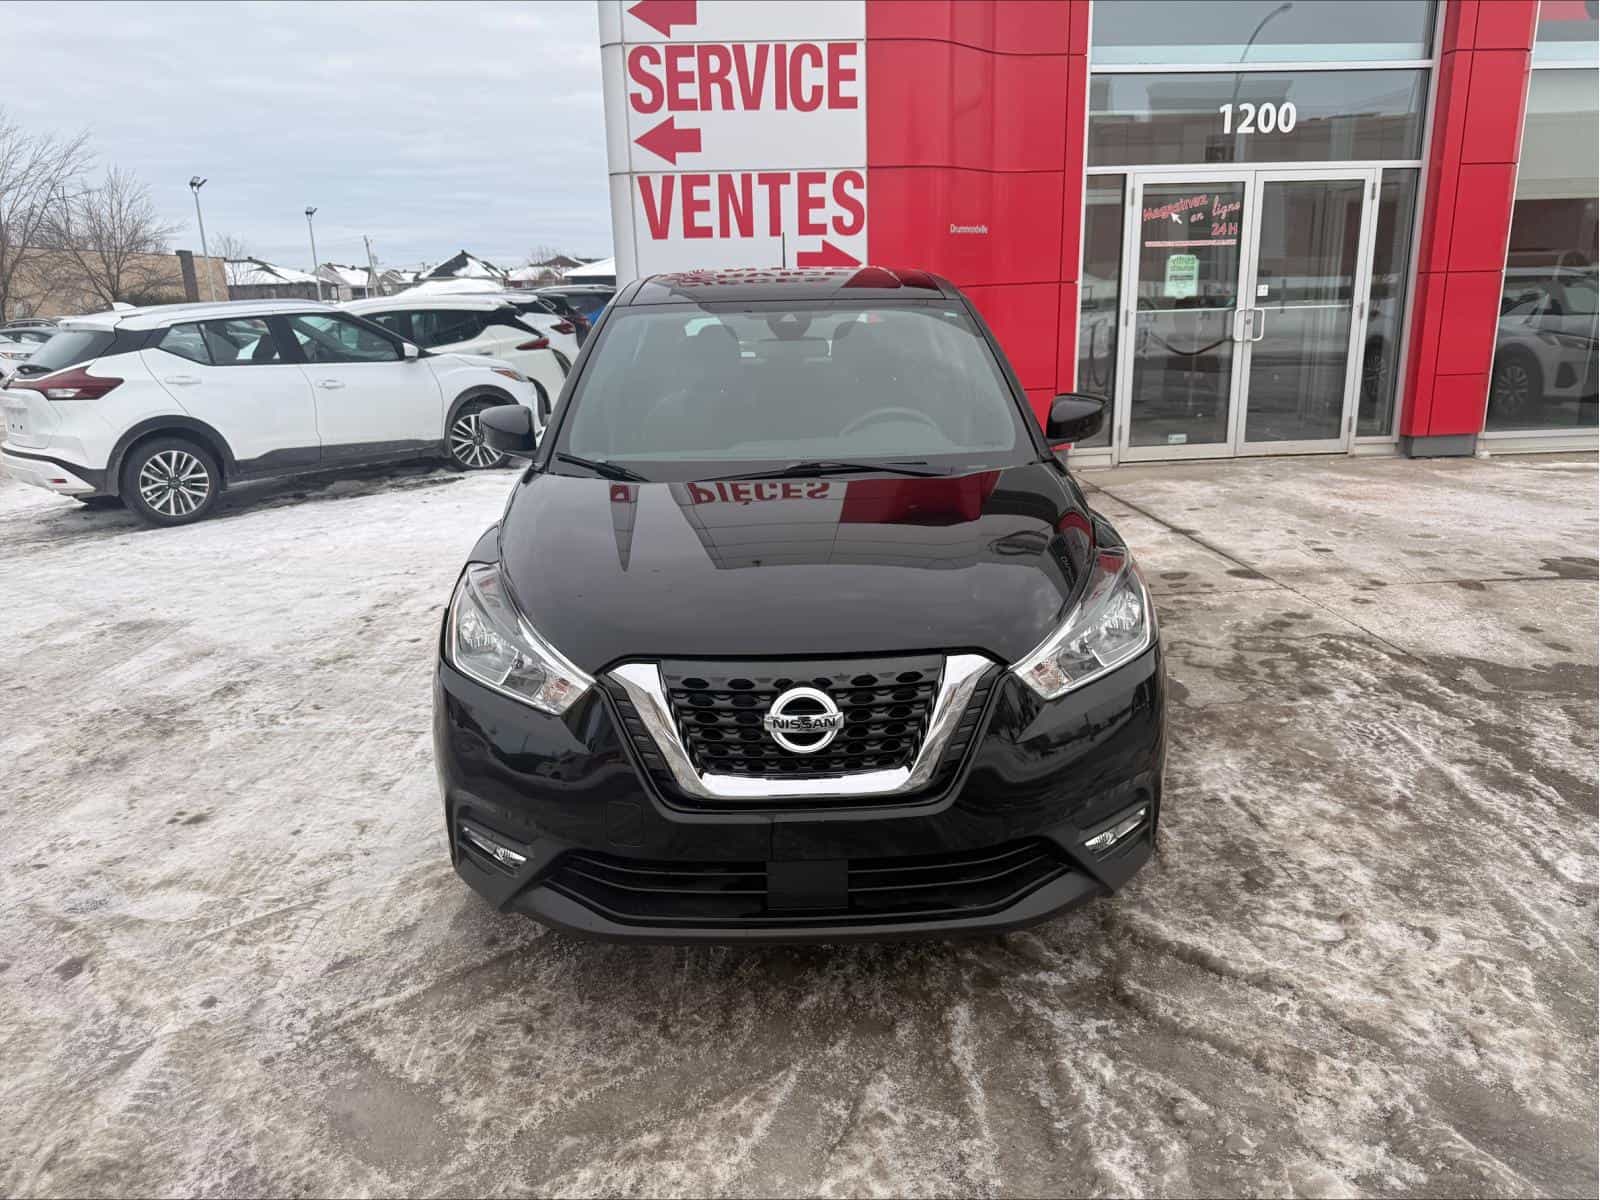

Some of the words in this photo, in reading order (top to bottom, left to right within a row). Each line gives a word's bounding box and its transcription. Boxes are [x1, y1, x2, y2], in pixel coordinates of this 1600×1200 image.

[627, 42, 859, 114] SERVICE
[1219, 102, 1297, 134] 1200
[637, 170, 866, 240] VENTES
[773, 718, 836, 729] NISSAN
